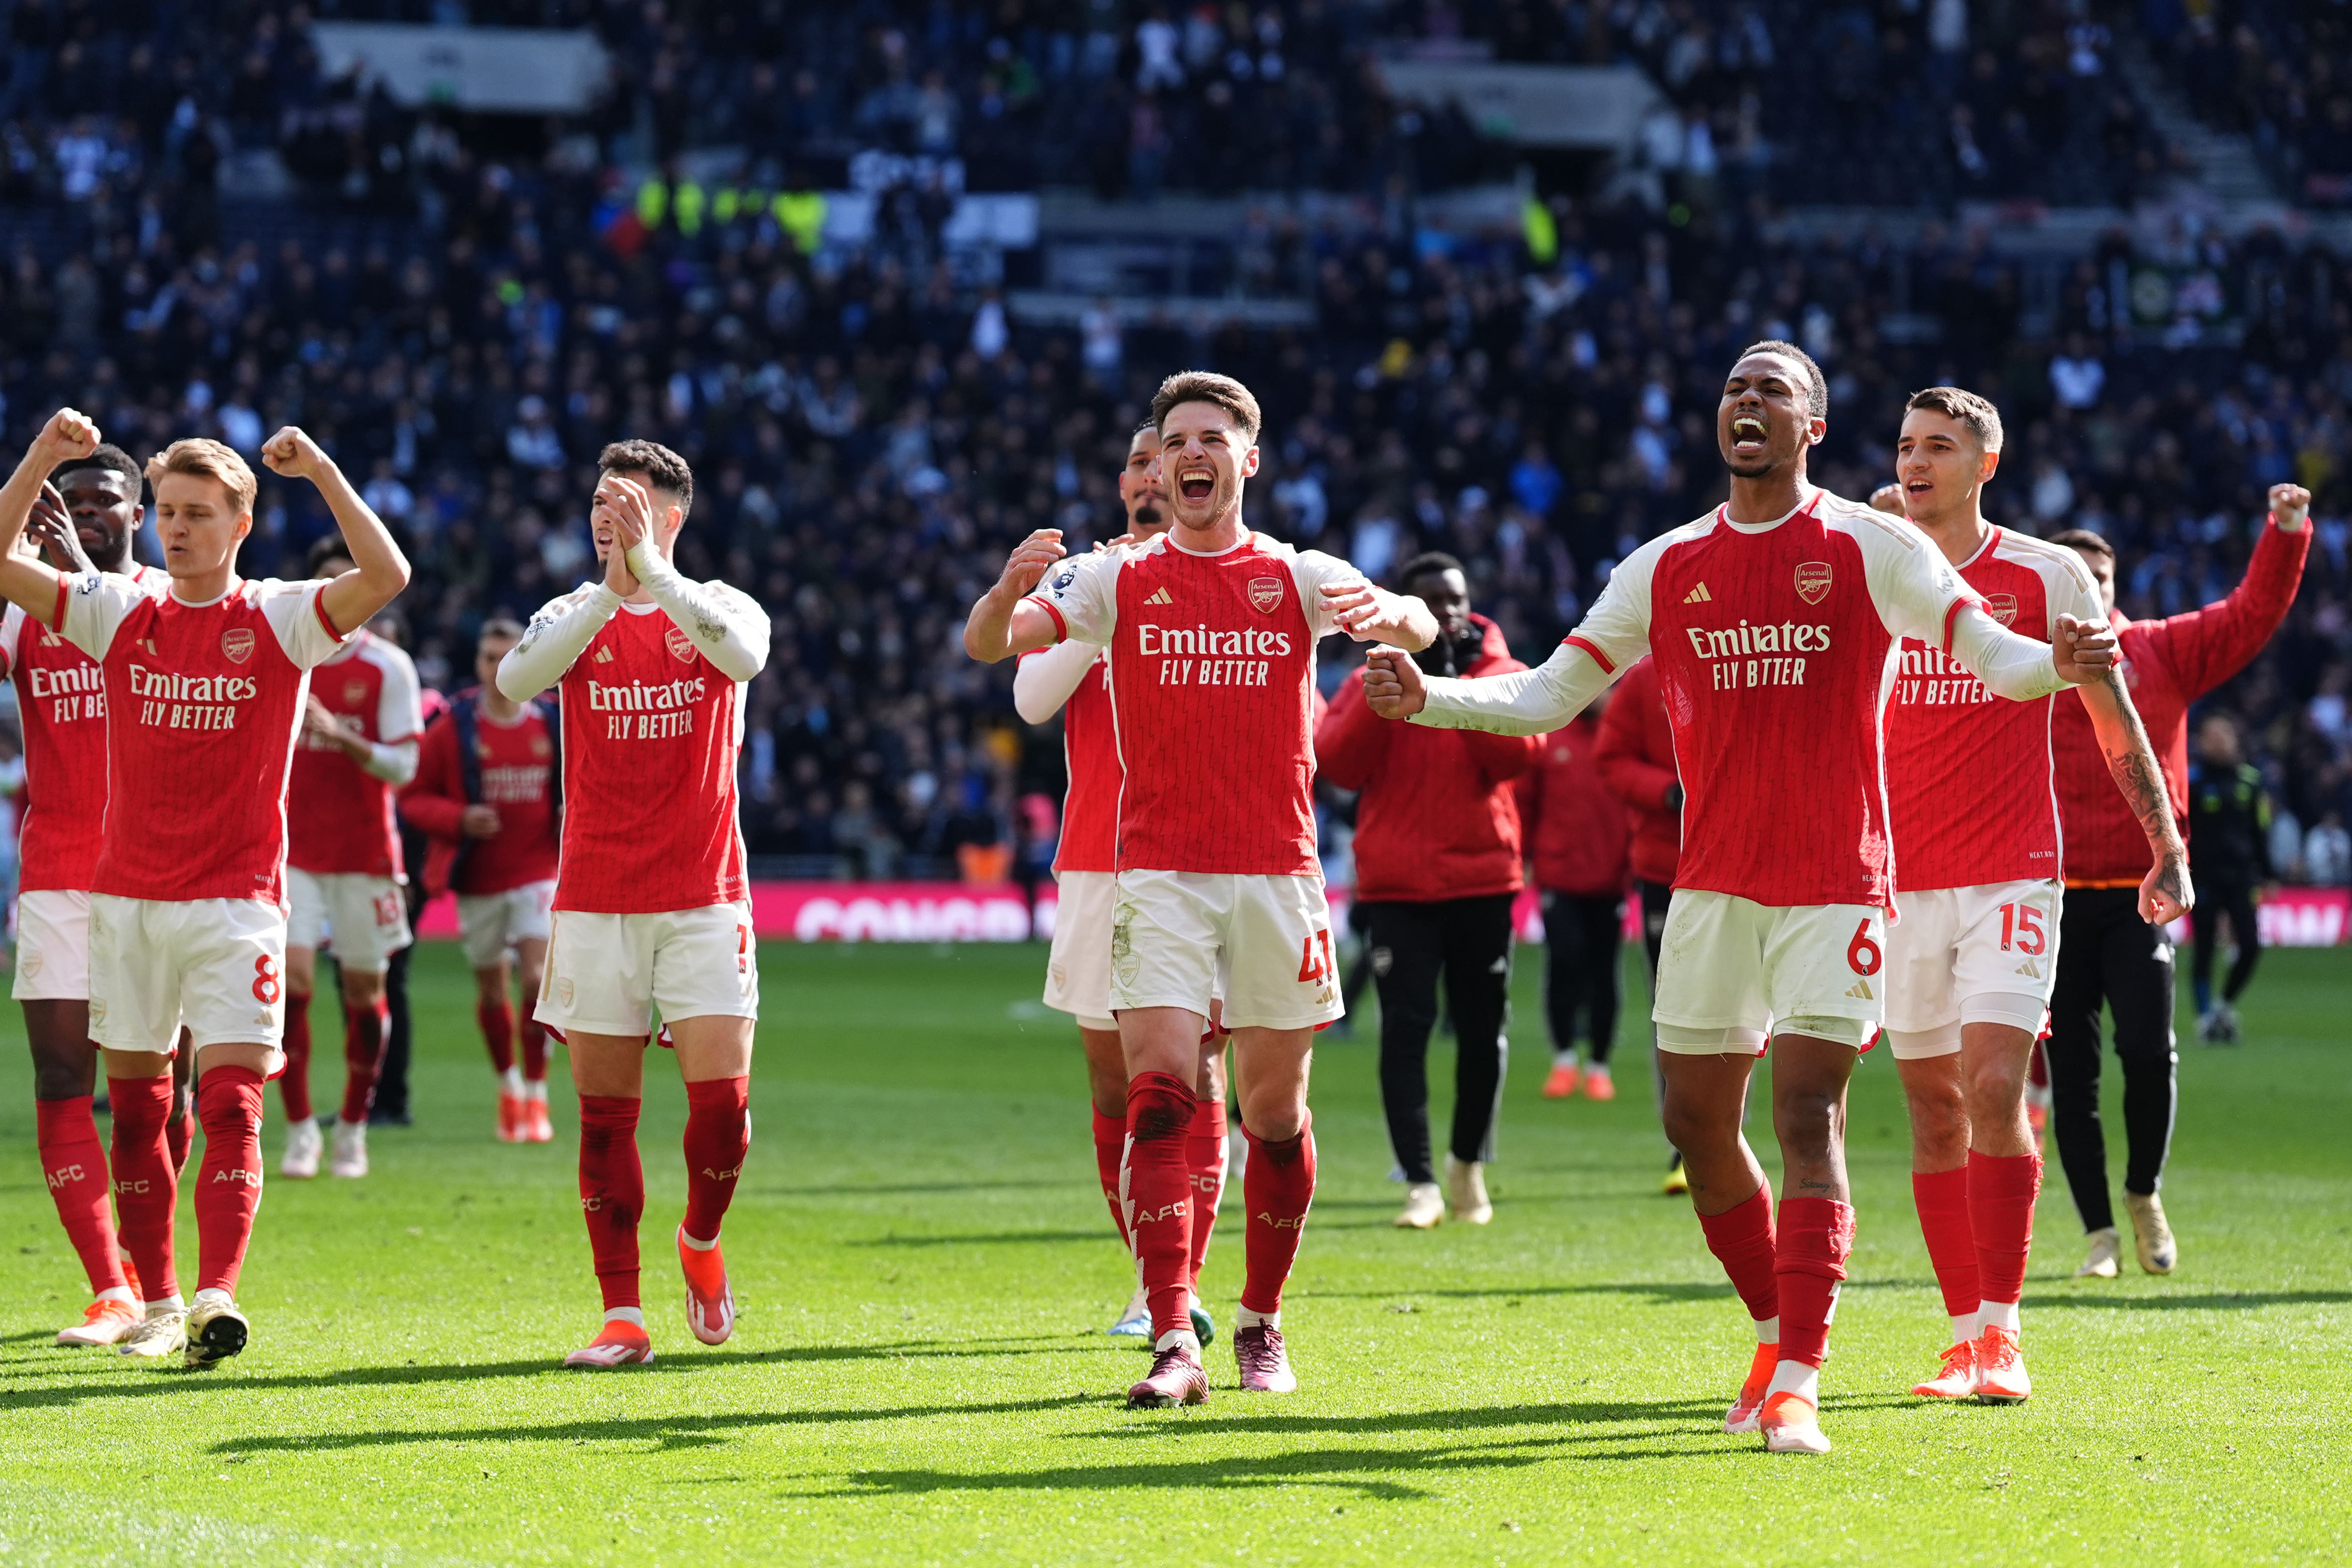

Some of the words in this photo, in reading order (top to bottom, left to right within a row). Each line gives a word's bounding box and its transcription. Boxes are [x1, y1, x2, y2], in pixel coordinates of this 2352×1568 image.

[1138, 623, 1291, 656] Emirates
[1686, 619, 1831, 659] Emirates
[1160, 660, 1193, 685] FLY
[1199, 660, 1269, 686] BETTER
[1900, 643, 1969, 675] mira
[30, 661, 104, 697] Emir
[129, 664, 256, 701] Emirates
[1713, 661, 1739, 690] FLY
[55, 695, 80, 724] FLY
[587, 677, 706, 710] Emirates
[141, 700, 166, 726] FLY
[170, 704, 235, 730] BETTER
[607, 715, 632, 739] FLY
[638, 709, 693, 739] BETTER
[1999, 902, 2046, 956] 15
[1299, 928, 1332, 986] 41
[1847, 918, 1882, 976] 6
[252, 954, 281, 1005] 8
[47, 1164, 85, 1190] AFC
[213, 1169, 258, 1189] AFC
[1137, 1201, 1187, 1224] AFC
[1257, 1212, 1306, 1229] AFC
